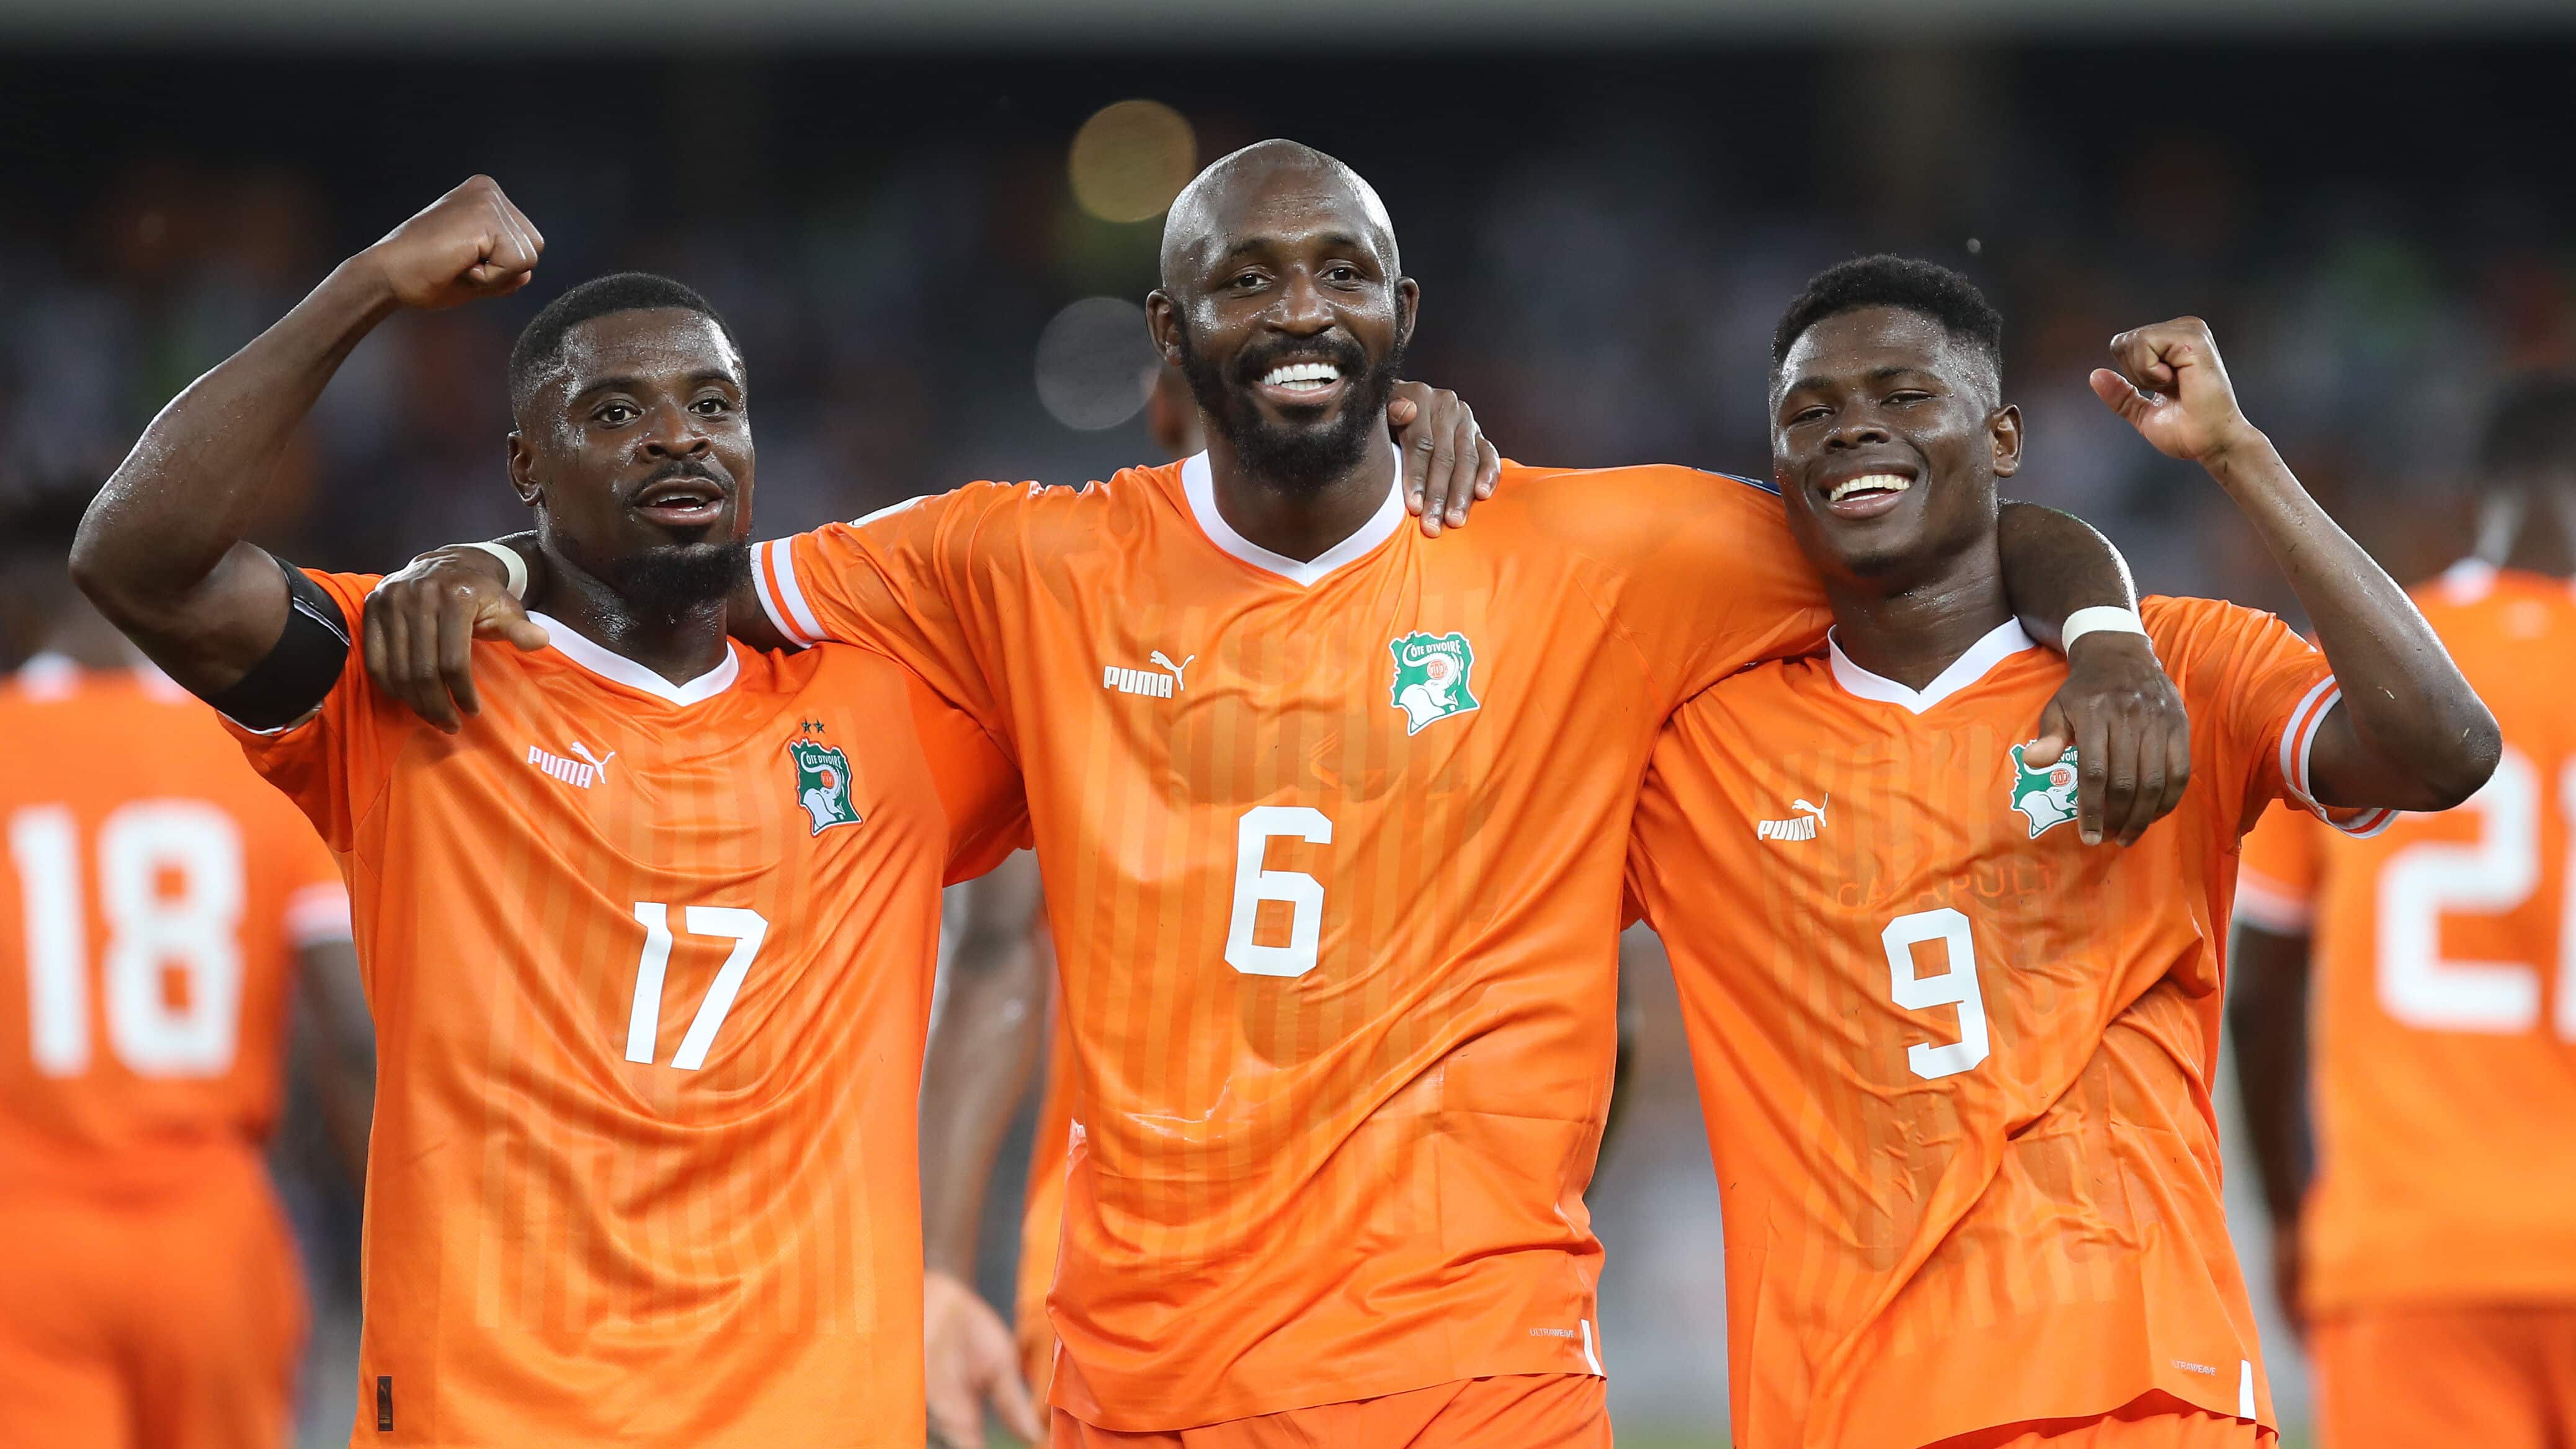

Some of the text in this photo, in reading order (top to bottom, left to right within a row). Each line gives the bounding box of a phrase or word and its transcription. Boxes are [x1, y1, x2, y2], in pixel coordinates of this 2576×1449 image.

[1426, 640, 1461, 655] D'IVOIRE
[1103, 666, 1174, 698] PUMA
[527, 744, 594, 789] PUMA
[1757, 814, 1816, 841] PUMA
[1224, 806, 1332, 978] 6
[1838, 864, 2057, 908] CAAPULT
[7, 799, 246, 1078] 18
[625, 901, 769, 1071] 17
[1881, 907, 1990, 1081] 9
[1529, 1328, 1574, 1338] ULTRAWEAVE
